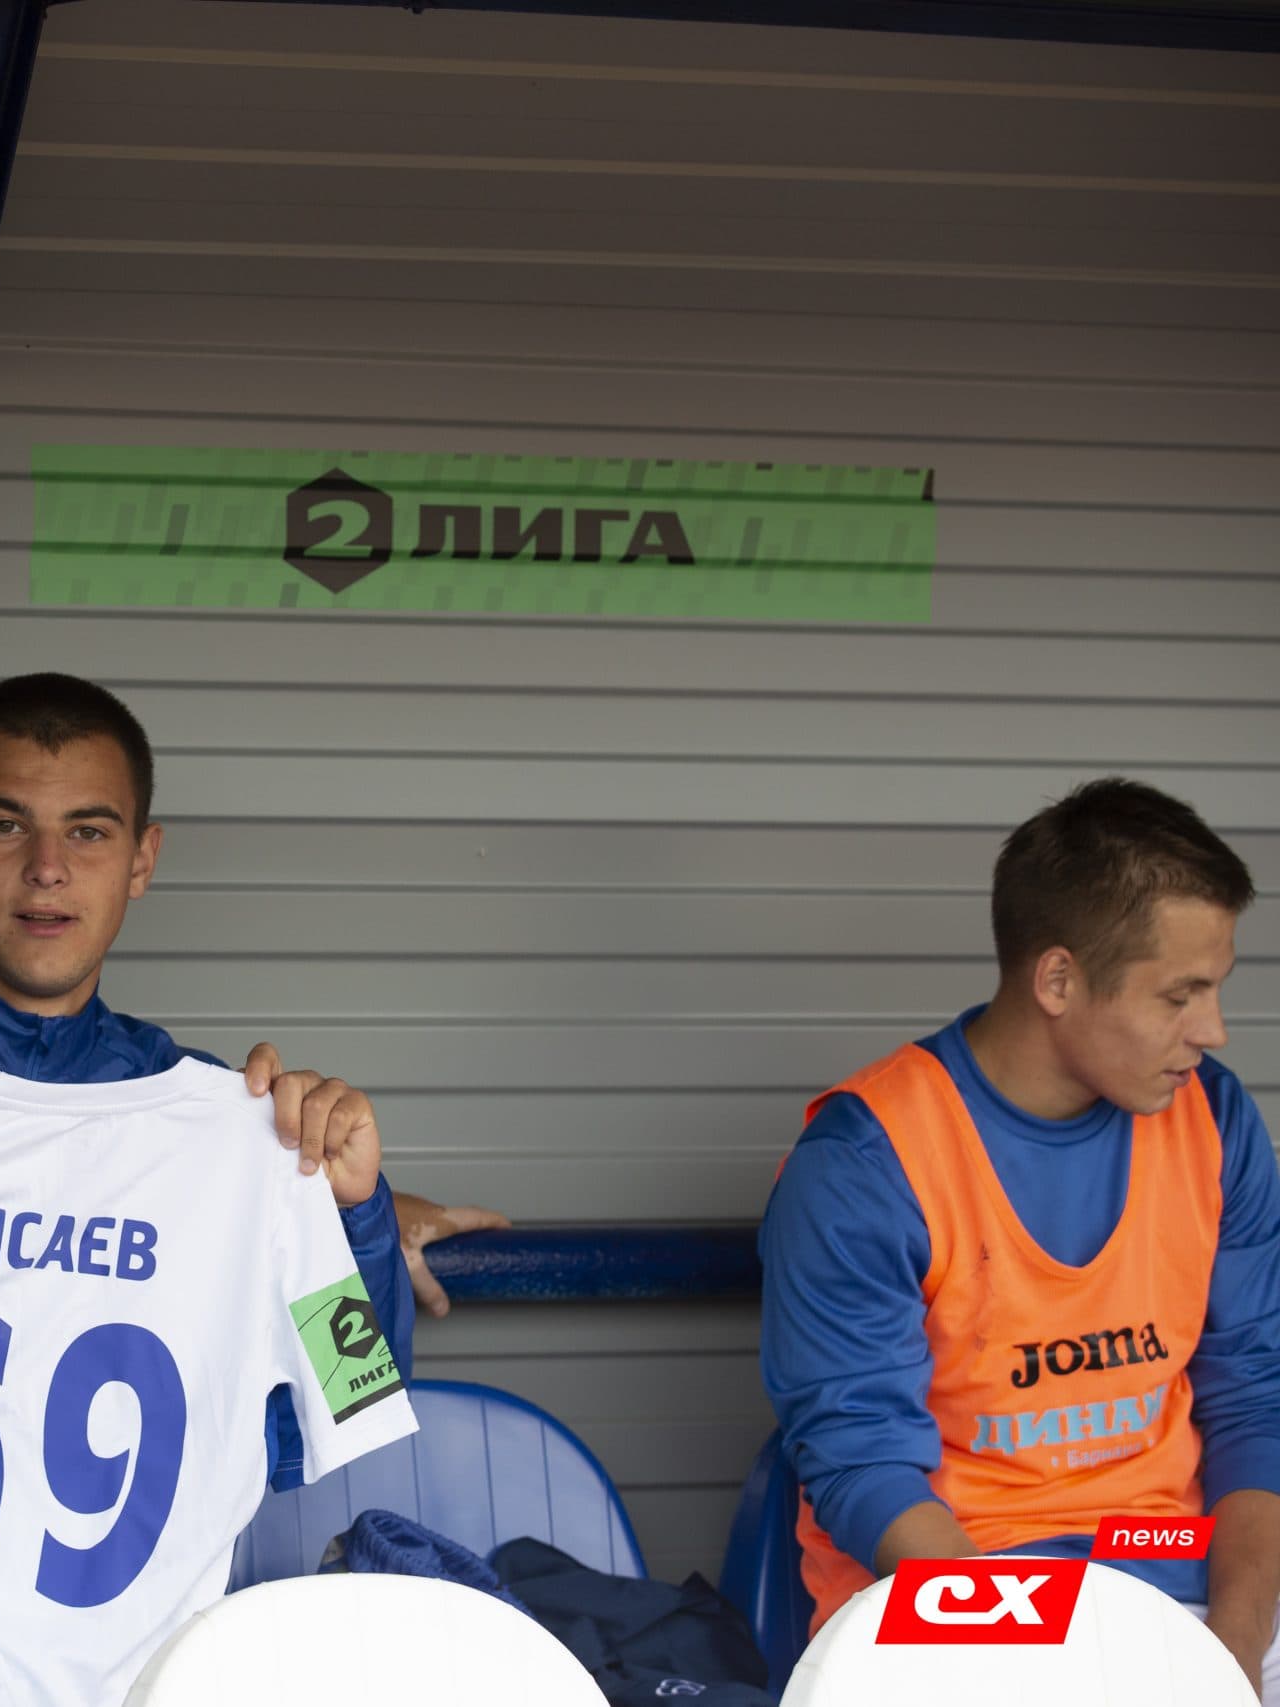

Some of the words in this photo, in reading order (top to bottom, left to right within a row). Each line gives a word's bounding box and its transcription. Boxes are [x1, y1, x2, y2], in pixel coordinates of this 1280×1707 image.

[304, 500, 373, 558] 2
[411, 504, 695, 564] ЛИГА
[338, 1310, 373, 1348] 2
